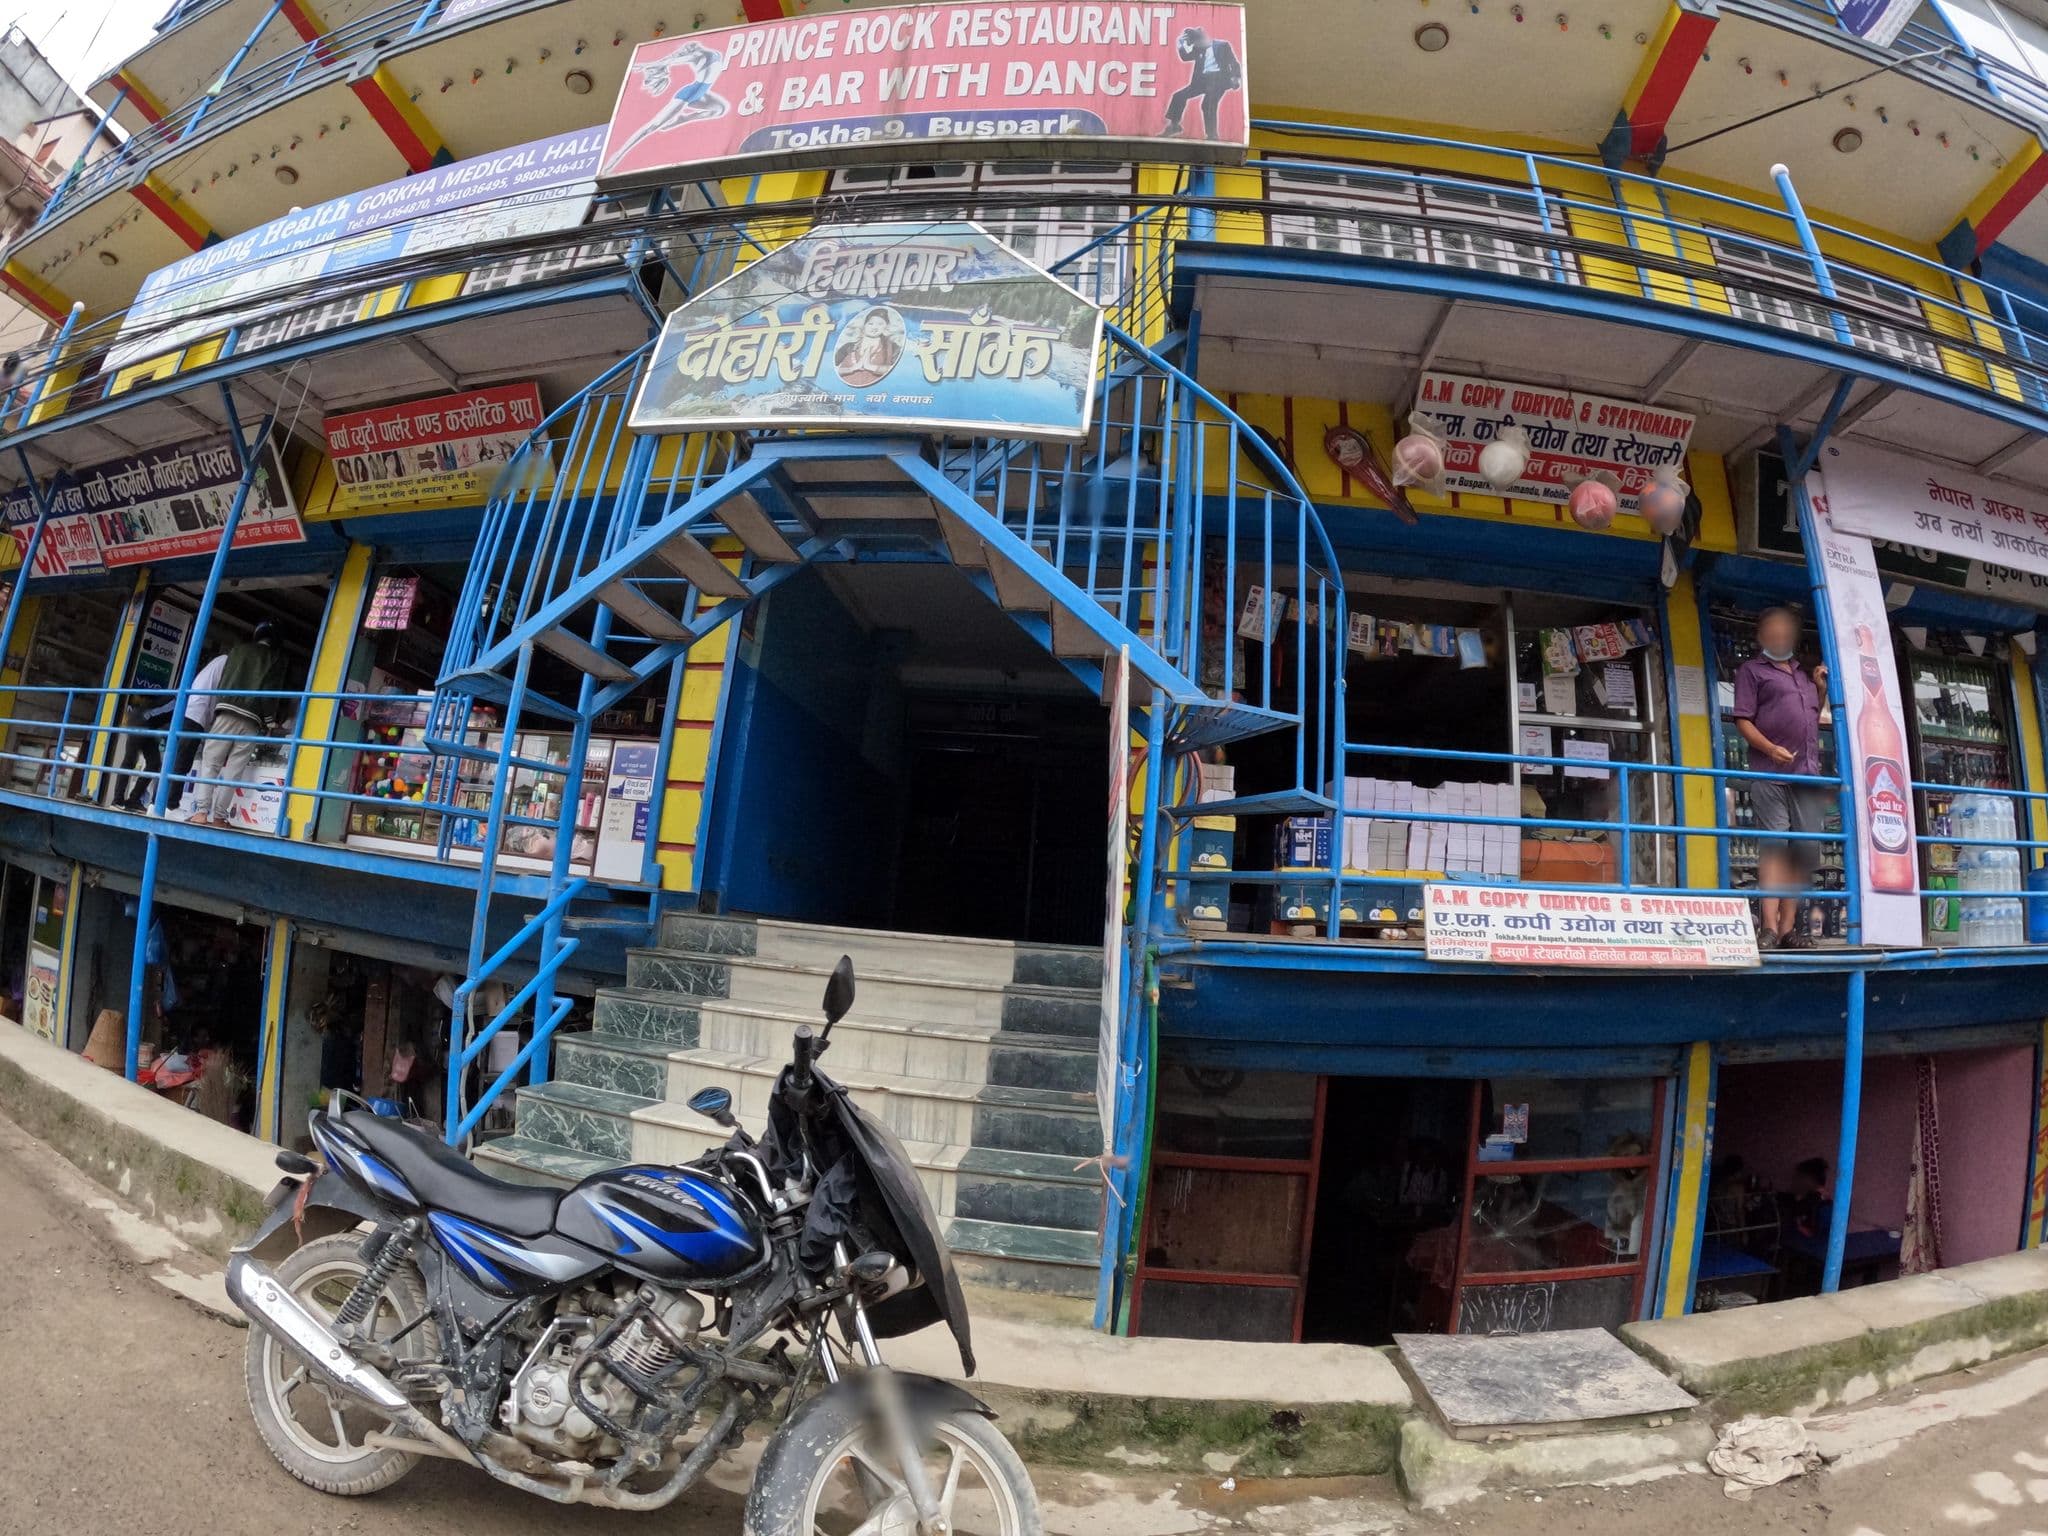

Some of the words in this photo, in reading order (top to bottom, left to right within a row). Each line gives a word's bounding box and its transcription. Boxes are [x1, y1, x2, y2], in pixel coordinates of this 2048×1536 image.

[722, 20, 839, 70] PRINCE
[844, 11, 941, 55] ROCK
[946, 7, 1176, 47] RESTAURANT
[737, 81, 765, 117] &
[779, 70, 864, 112] BAR
[878, 61, 991, 101] WITH
[1004, 60, 1158, 97] DANCE
[928, 114, 1081, 137] Buspark
[356, 175, 437, 214] GORKHA
[441, 154, 535, 188] MEDICAL
[542, 134, 602, 163] HALL
[172, 232, 260, 279] Helping
[260, 198, 351, 247] Health
[803, 242, 967, 299] हिमसागर
[677, 302, 837, 383] दोहोरी
[1421, 379, 1455, 403] A.M
[1461, 383, 1505, 410] COPY
[1511, 390, 1574, 420] UDHYOG
[1580, 402, 1593, 423] &
[1598, 404, 1692, 440] STATIONARY
[1571, 432, 1609, 457] तथा
[1613, 433, 1683, 466] स्टेशनरी
[1926, 478, 1975, 510] नेपाल
[1981, 497, 2026, 524] आइस
[1914, 511, 1942, 533] अब
[1948, 520, 1984, 543] नयाँ
[1826, 548, 1857, 565] EXTRA
[1871, 797, 1890, 811] Nepal
[1876, 814, 1902, 826] STRONG
[1432, 889, 1469, 906] A.M
[1479, 891, 1529, 908] COPY
[1539, 894, 1612, 912] UDHYOG
[1620, 898, 1632, 913] &
[1641, 899, 1744, 916] STATIONARY
[1504, 912, 1552, 930] कपी
[1560, 914, 1616, 933] उद्योग
[1623, 919, 1664, 934] तथा
[1670, 918, 1748, 937] स्टेशनरी
